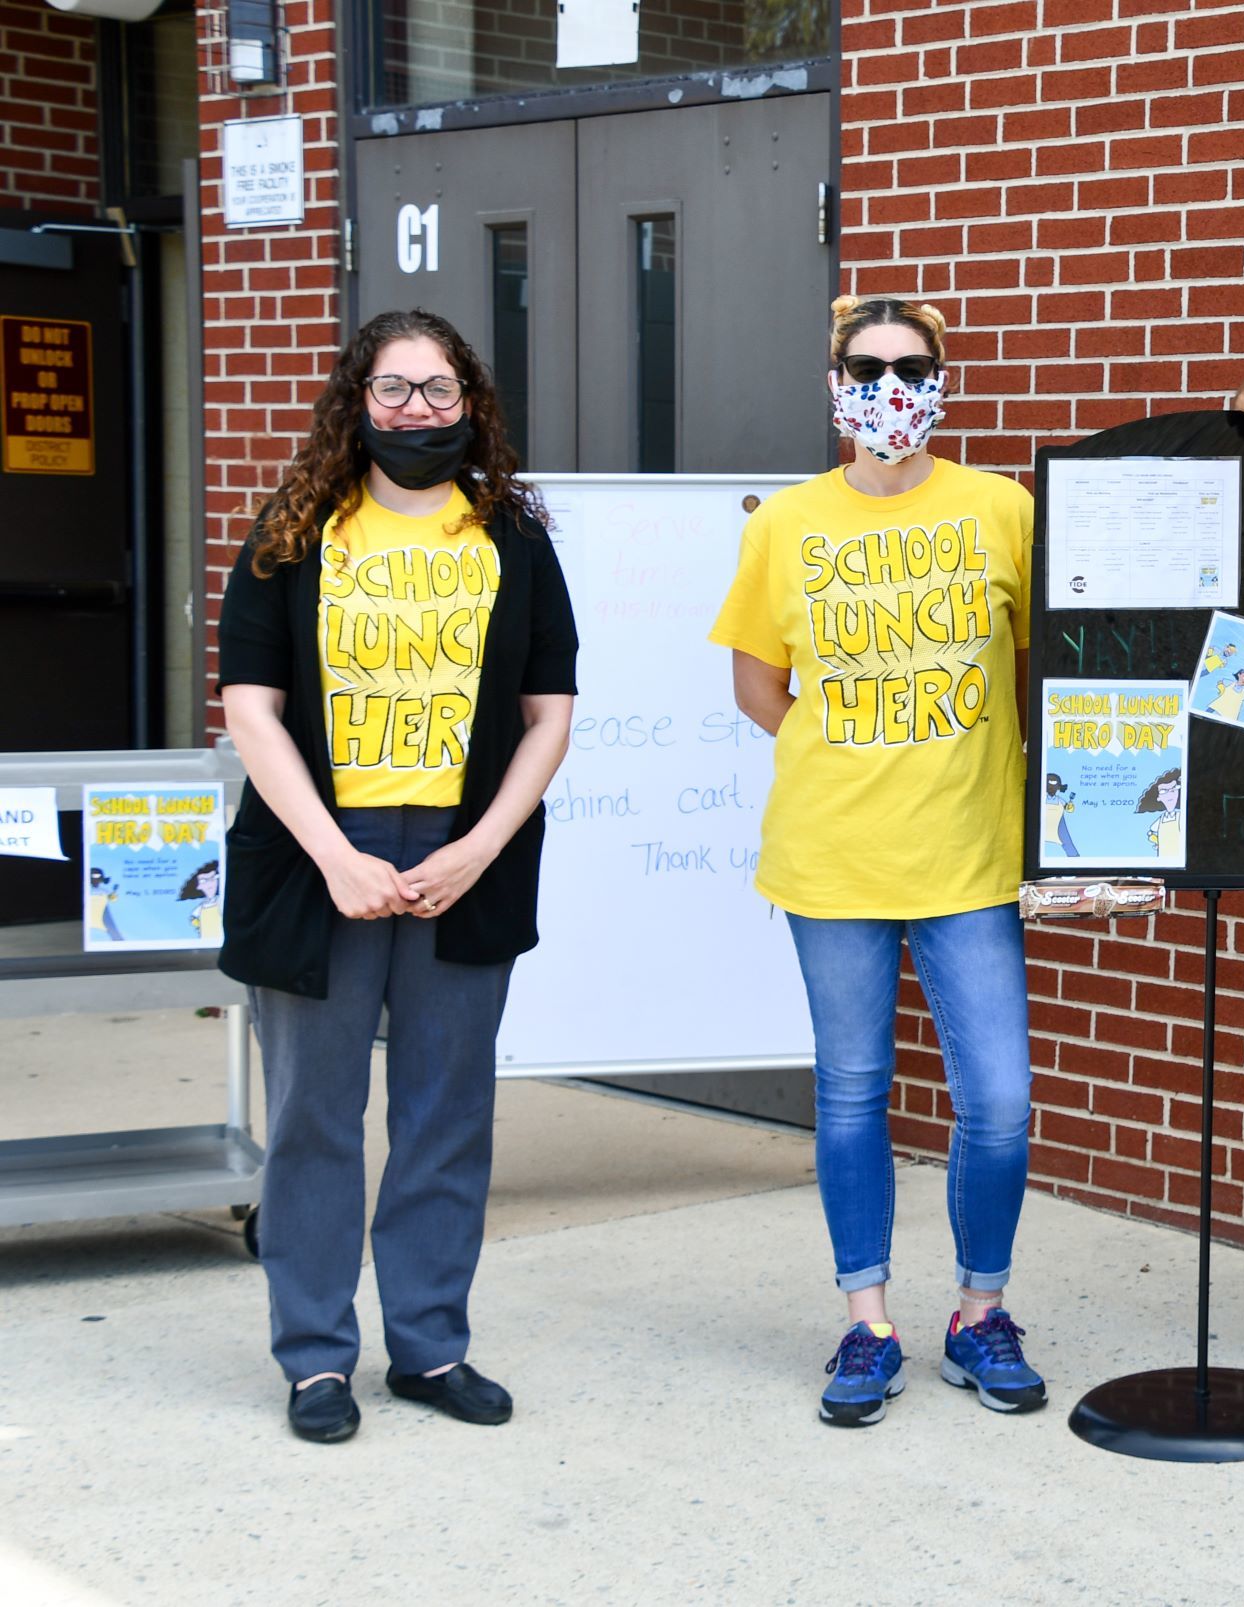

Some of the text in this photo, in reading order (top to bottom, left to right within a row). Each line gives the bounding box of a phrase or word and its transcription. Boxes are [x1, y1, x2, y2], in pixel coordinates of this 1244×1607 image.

[397, 203, 439, 273] C1
[21, 325, 41, 343] DO
[321, 545, 501, 600] SCHOOL
[801, 517, 987, 594] SCHOOL
[810, 578, 992, 658] LUNCH
[822, 664, 987, 745] HERO
[1047, 693, 1180, 718] SCHOOL LUNCH
[330, 692, 472, 769] HER
[572, 716, 676, 750] ease
[1053, 720, 1175, 751] HERO DAY
[1080, 773, 1098, 781] cape
[1123, 773, 1138, 781] you
[1115, 764, 1129, 772] for
[91, 795, 215, 817] SCHOOL LUNCH
[677, 773, 754, 814] cart.
[1082, 799, 1098, 808] May
[96, 820, 209, 845] HERO DAY
[631, 840, 760, 886] Thank yo
